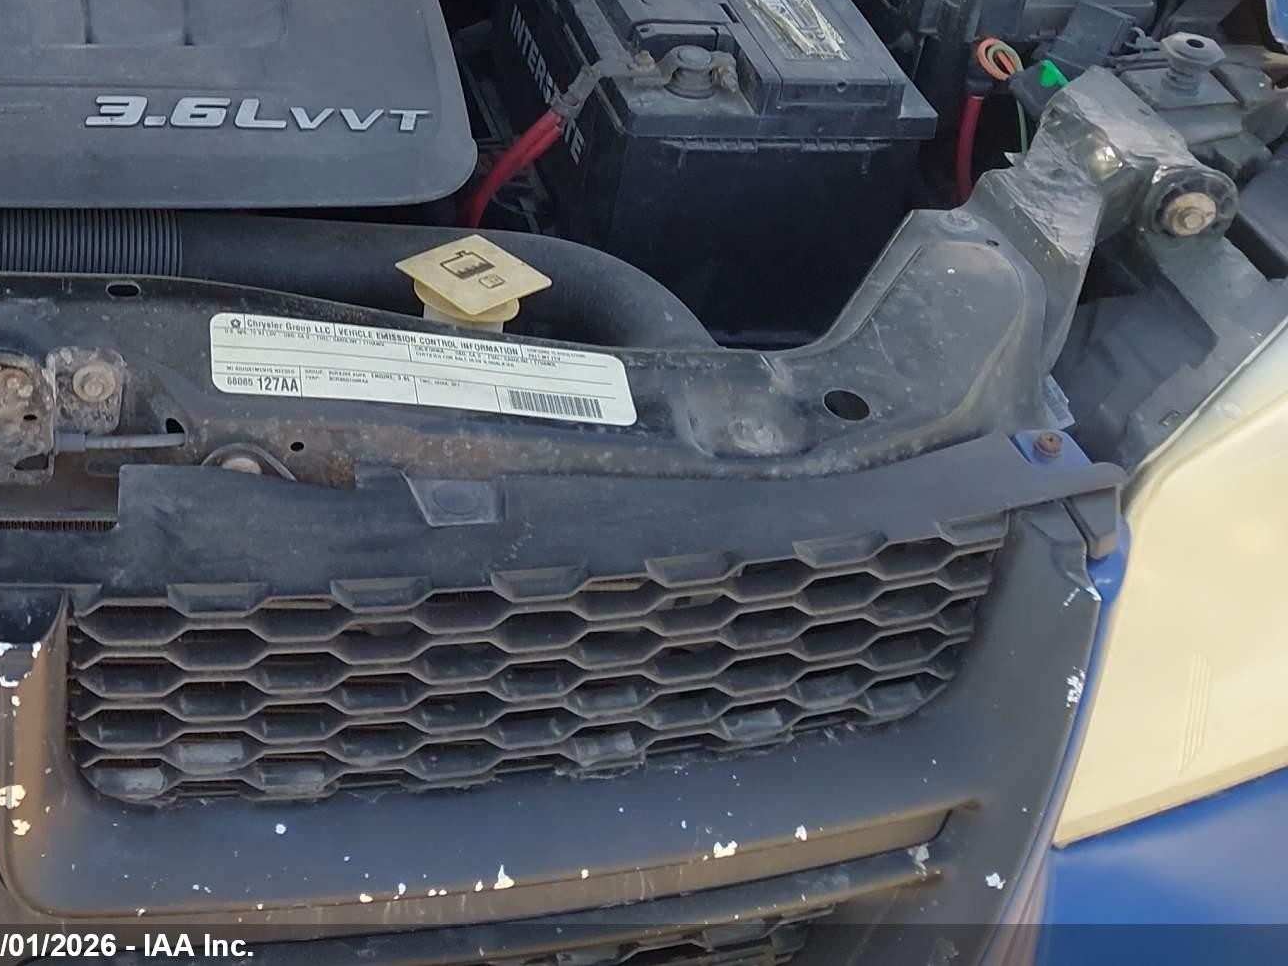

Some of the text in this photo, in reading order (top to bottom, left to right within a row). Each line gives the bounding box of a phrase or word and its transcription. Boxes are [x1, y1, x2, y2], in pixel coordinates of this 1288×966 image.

[511, 3, 585, 166] INTERSTE
[247, 319, 331, 335] Chrysler Group LLC
[338, 327, 373, 340] VEHICLE
[376, 331, 416, 344] EMISSION
[419, 336, 458, 349] CONTROL
[460, 340, 519, 356] INFORMATION
[257, 376, 300, 393] 127AA
